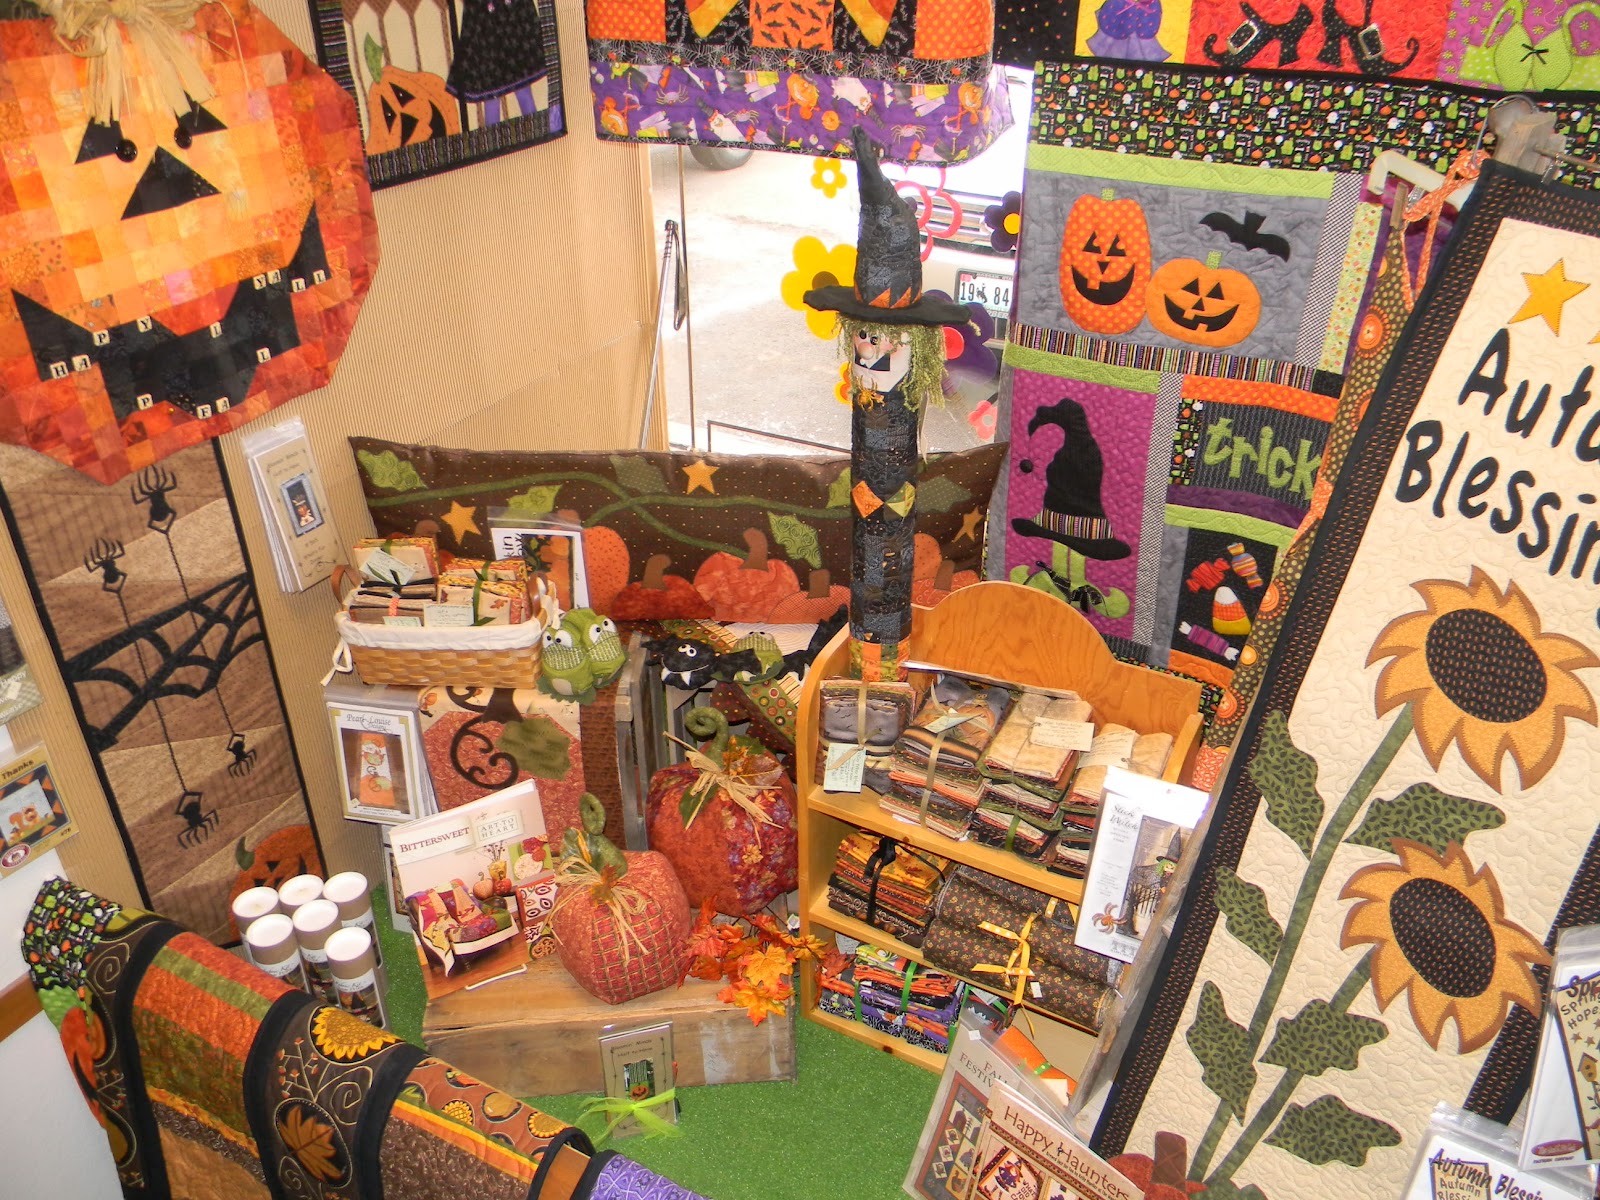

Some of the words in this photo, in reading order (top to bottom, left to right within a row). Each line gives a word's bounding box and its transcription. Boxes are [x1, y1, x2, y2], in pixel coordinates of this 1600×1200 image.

[961, 282, 975, 301] 19
[994, 287, 1010, 306] 84
[1204, 417, 1322, 500] trick
[2, 760, 34, 779] Thanks
[400, 827, 470, 853] BITTERSWEET
[481, 824, 515, 839] HEART
[1004, 1106, 1054, 1152] Happy
[1056, 1142, 1130, 1200] Haunters
[1430, 1148, 1493, 1188] Autumn
[1439, 1177, 1481, 1197] Autumn
